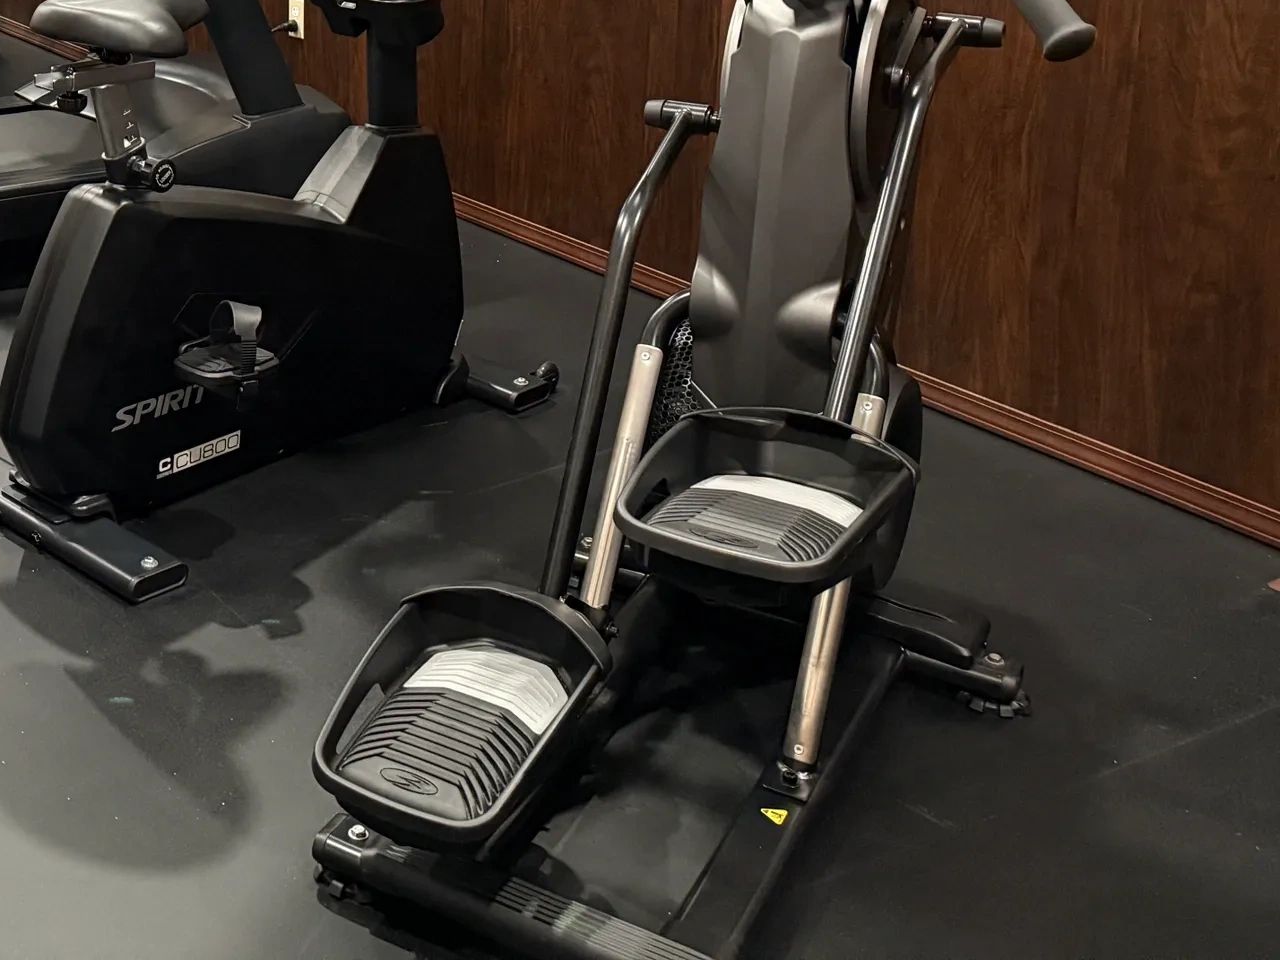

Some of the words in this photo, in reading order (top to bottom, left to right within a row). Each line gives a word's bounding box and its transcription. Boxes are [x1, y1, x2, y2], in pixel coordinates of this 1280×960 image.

[111, 384, 205, 432] SPIRIT
[158, 457, 172, 473] C
[175, 433, 239, 470] CU800
